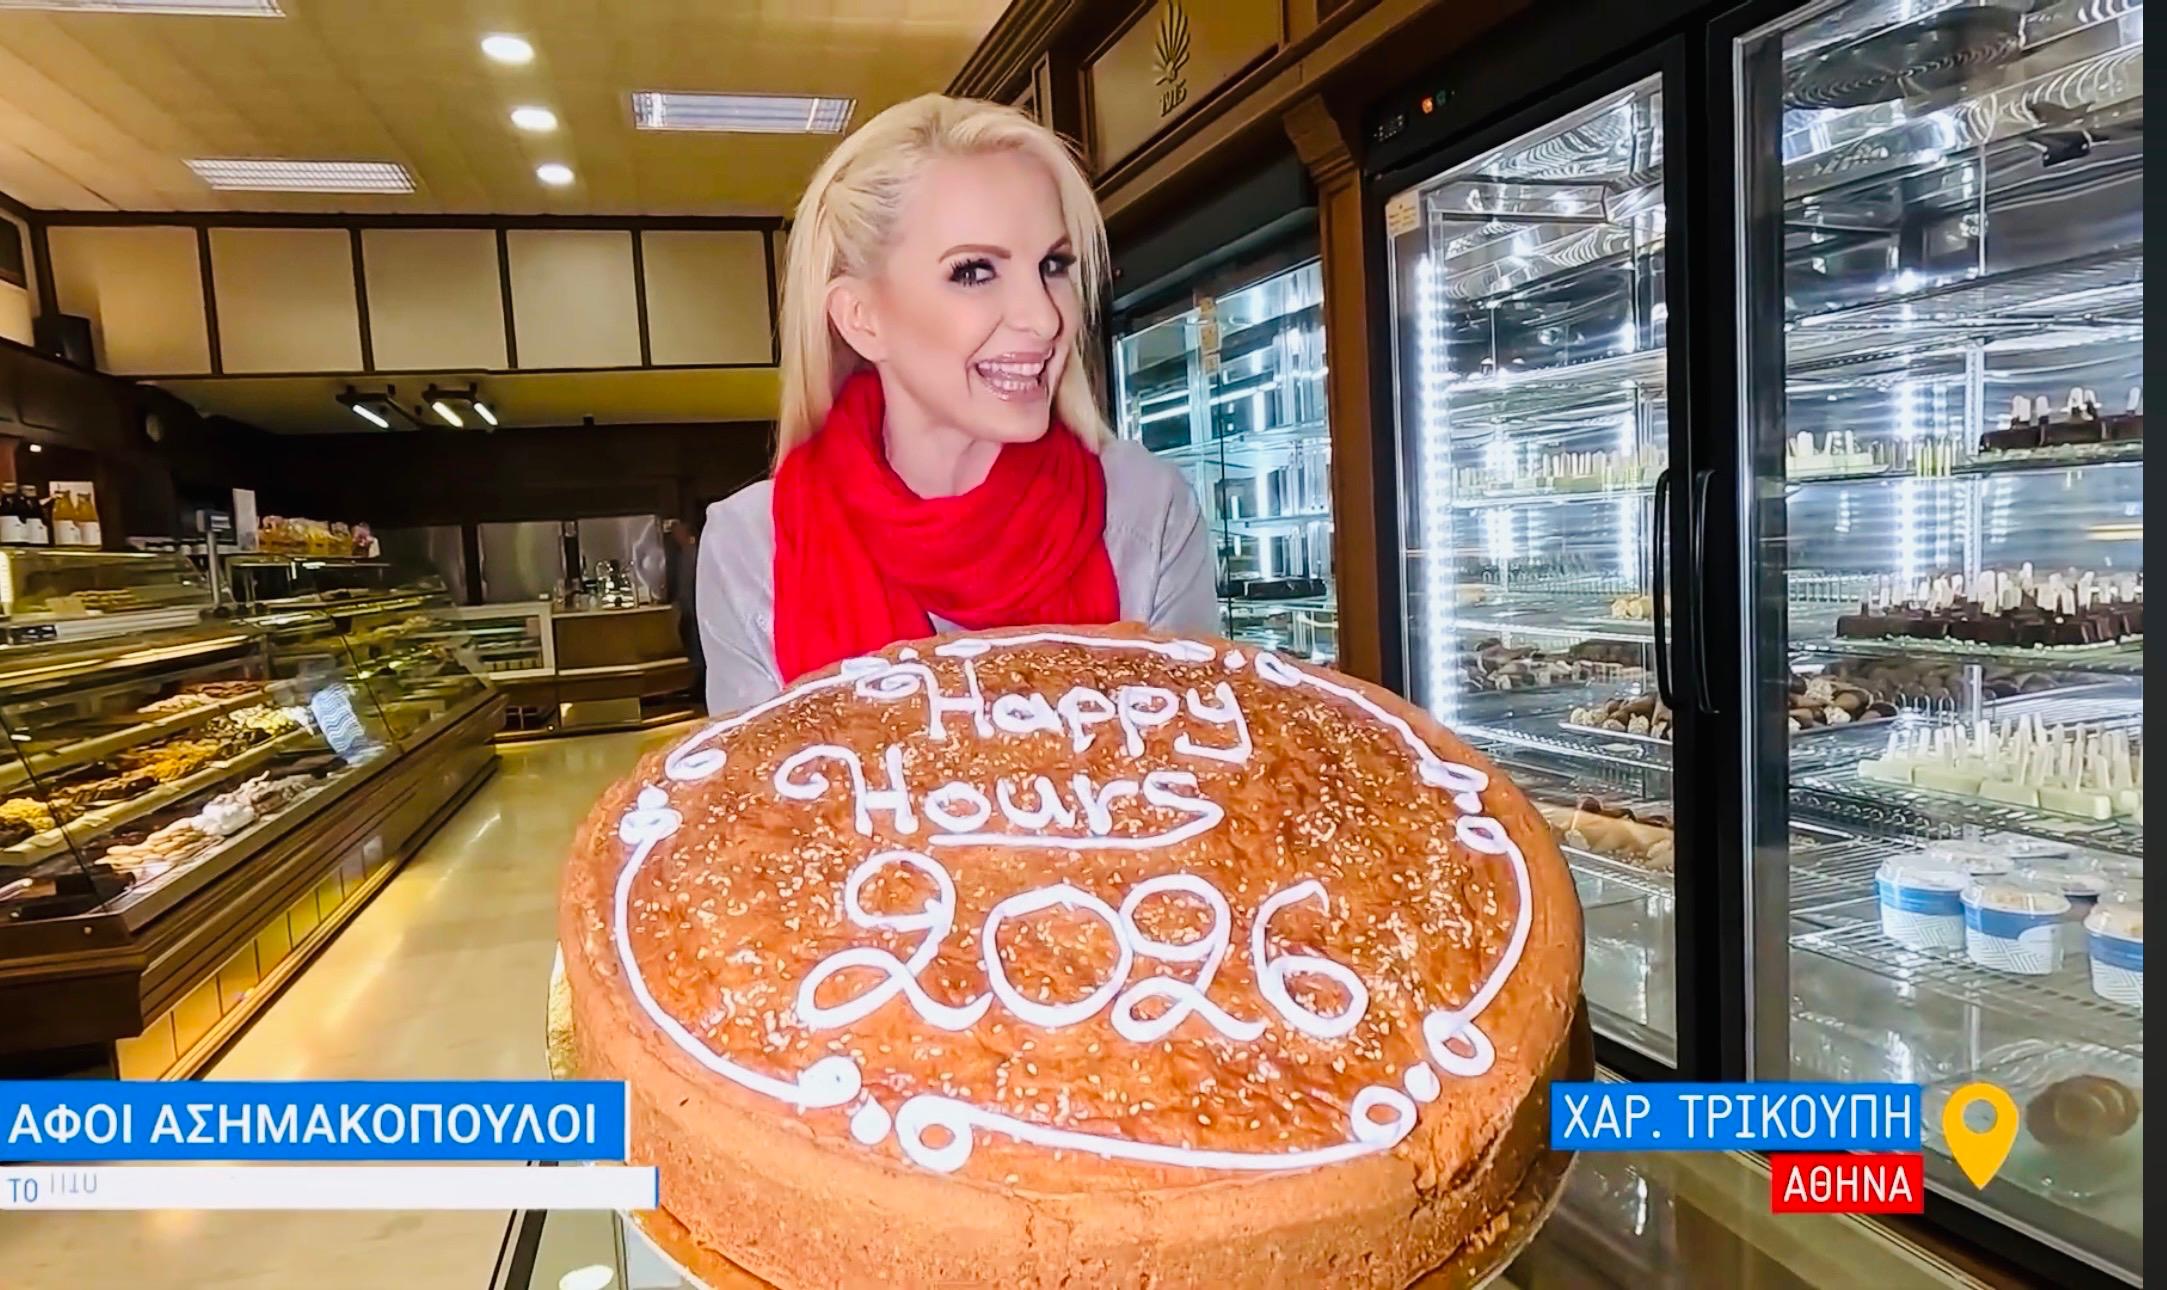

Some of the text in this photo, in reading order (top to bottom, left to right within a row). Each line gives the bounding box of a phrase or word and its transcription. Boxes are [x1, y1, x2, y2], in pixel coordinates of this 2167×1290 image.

[856, 659, 1254, 765] Happy
[774, 743, 1226, 842] Hours
[796, 849, 1370, 1043] 2026
